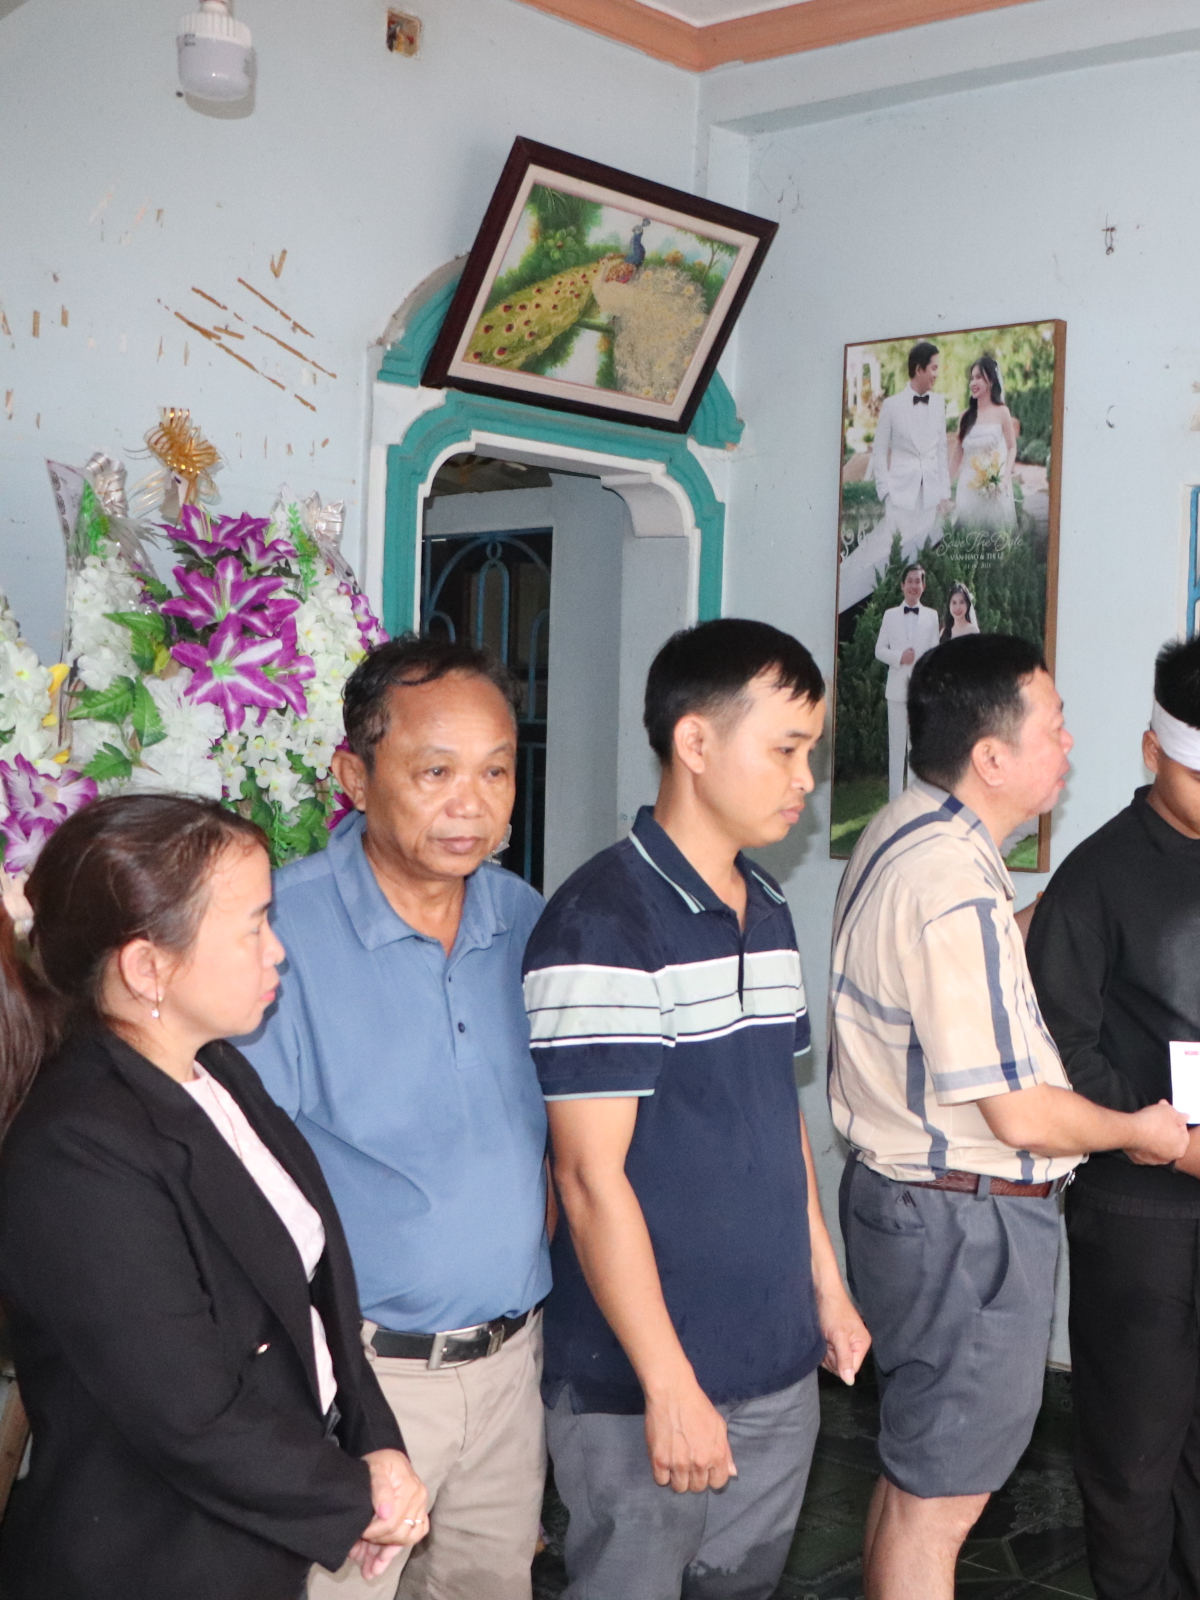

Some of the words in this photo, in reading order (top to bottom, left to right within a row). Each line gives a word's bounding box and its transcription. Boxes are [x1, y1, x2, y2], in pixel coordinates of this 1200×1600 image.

[936, 532, 966, 556] Save
[965, 530, 992, 552] The
[991, 531, 1024, 552] Date
